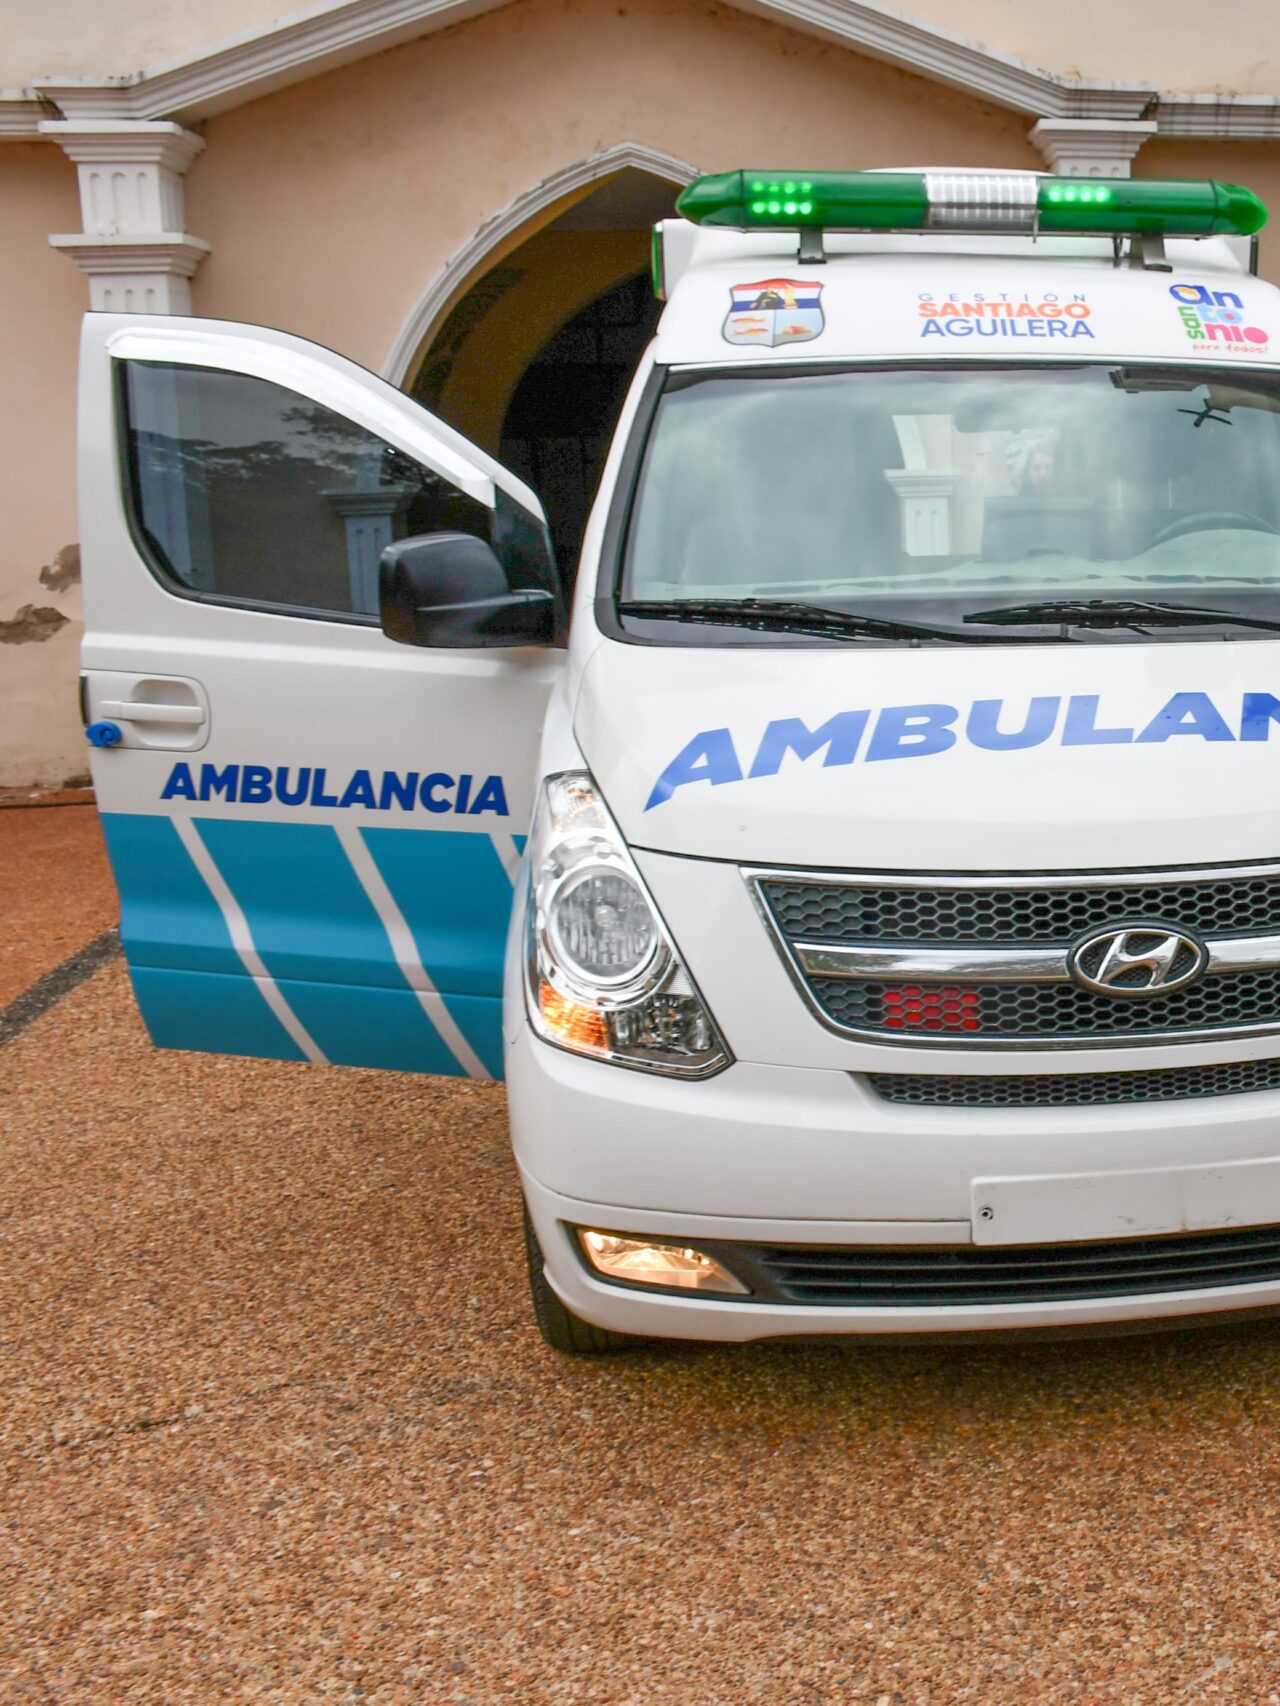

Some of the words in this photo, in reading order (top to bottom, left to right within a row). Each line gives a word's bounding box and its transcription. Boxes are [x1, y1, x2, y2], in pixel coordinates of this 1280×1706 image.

[918, 292, 1086, 302] GESTIÓN
[918, 302, 1091, 319] SANTIAGO
[920, 318, 1096, 339] AGUILERA
[160, 762, 510, 816] AMBULANCIA
